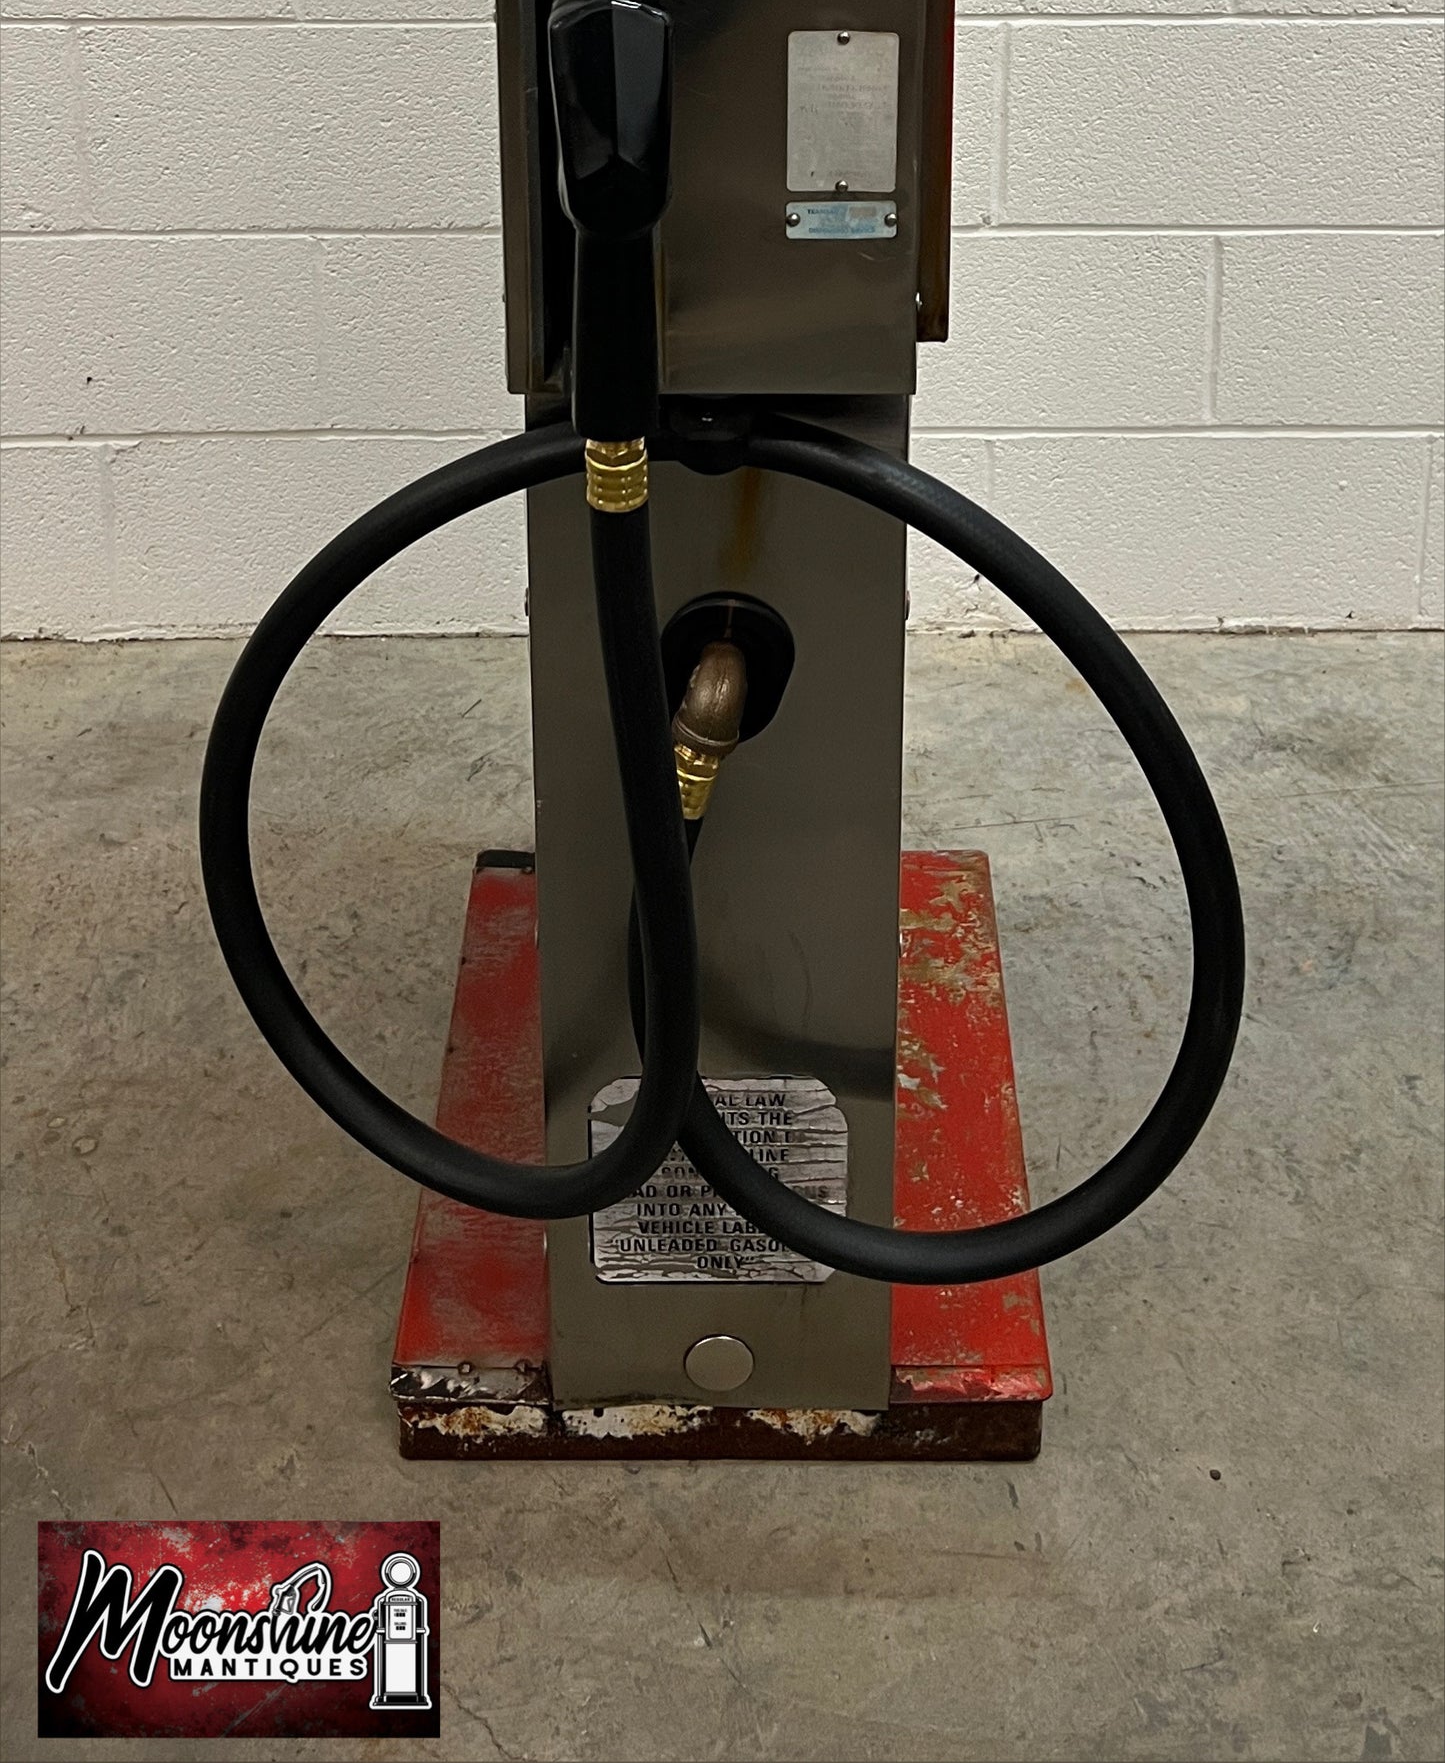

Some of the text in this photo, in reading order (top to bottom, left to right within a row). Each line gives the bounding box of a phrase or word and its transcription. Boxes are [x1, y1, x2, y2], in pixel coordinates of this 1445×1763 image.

[745, 1093, 786, 1107] LAW
[758, 1111, 793, 1126] THE
[667, 1185, 692, 1197] OR
[637, 1203, 727, 1216] INTO ANY
[638, 1221, 714, 1234] VEHICLE
